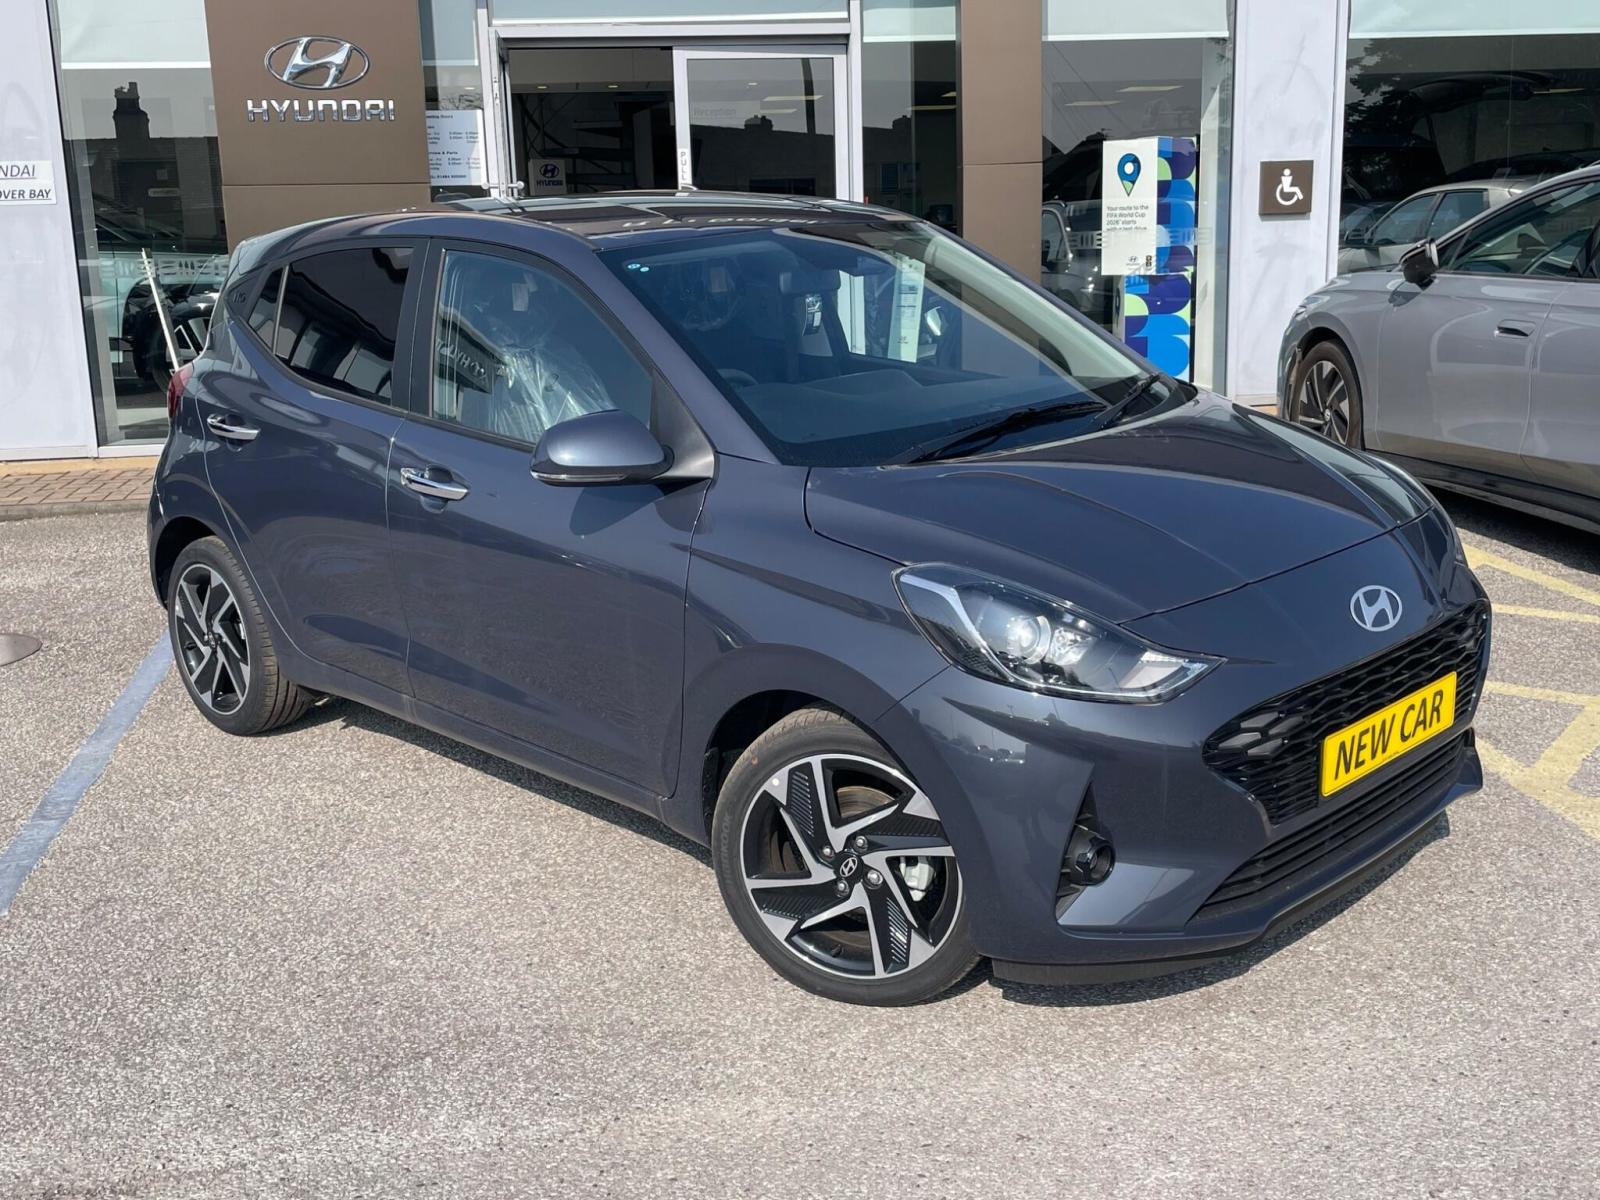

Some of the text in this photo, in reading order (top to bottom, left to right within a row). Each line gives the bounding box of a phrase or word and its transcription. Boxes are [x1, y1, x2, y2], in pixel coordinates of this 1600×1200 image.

[246, 99, 395, 122] HYUNDAI
[29, 188, 51, 199] BAY
[1334, 689, 1444, 781] NEW CAR
